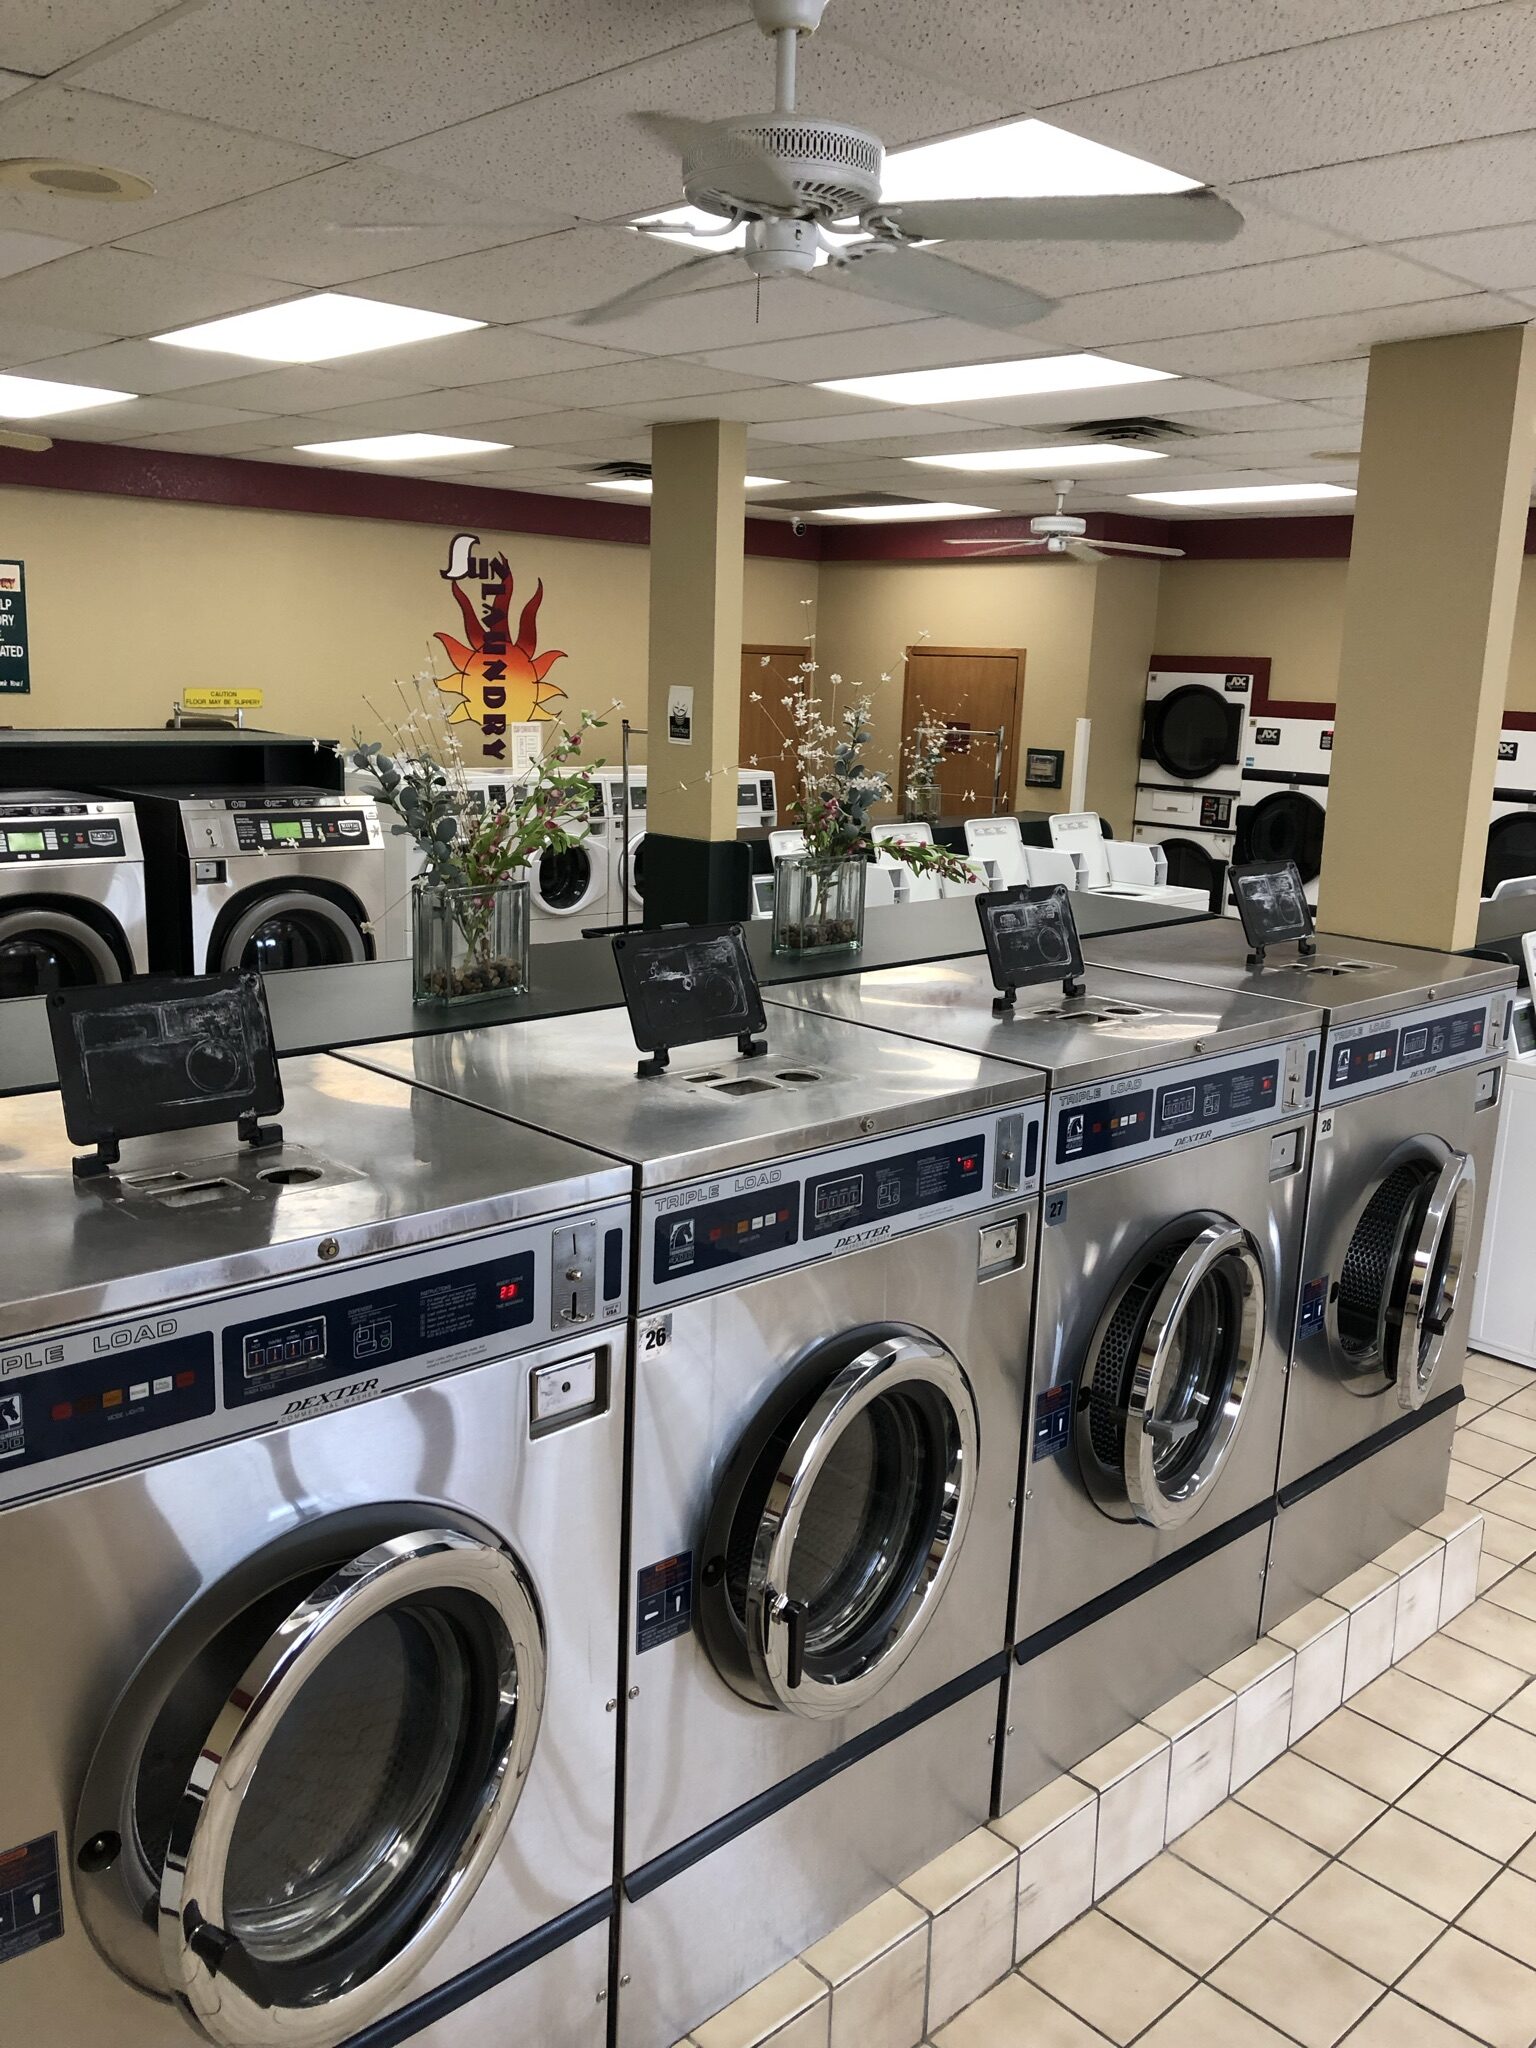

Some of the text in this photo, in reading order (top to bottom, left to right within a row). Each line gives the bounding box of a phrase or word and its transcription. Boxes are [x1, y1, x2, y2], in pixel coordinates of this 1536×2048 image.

[0, 599, 12, 611] LP
[481, 583, 508, 760] LAUNDRY
[1231, 677, 1247, 686] ADC
[1261, 729, 1278, 739] ADC
[1060, 1079, 1142, 1106] TRIPLE LOAD
[1321, 1118, 1331, 1133] 28
[1174, 1130, 1213, 1146] DEXTER
[655, 1170, 781, 1211] TRIPLE LOAD
[1050, 1200, 1063, 1218] 27
[835, 1225, 890, 1248] DEXTER
[93, 1319, 177, 1353] LOAD
[645, 1327, 666, 1350] 26
[281, 1378, 378, 1416] DEXTER
[281, 1390, 378, 1423] COMMERCIAL WASHER
